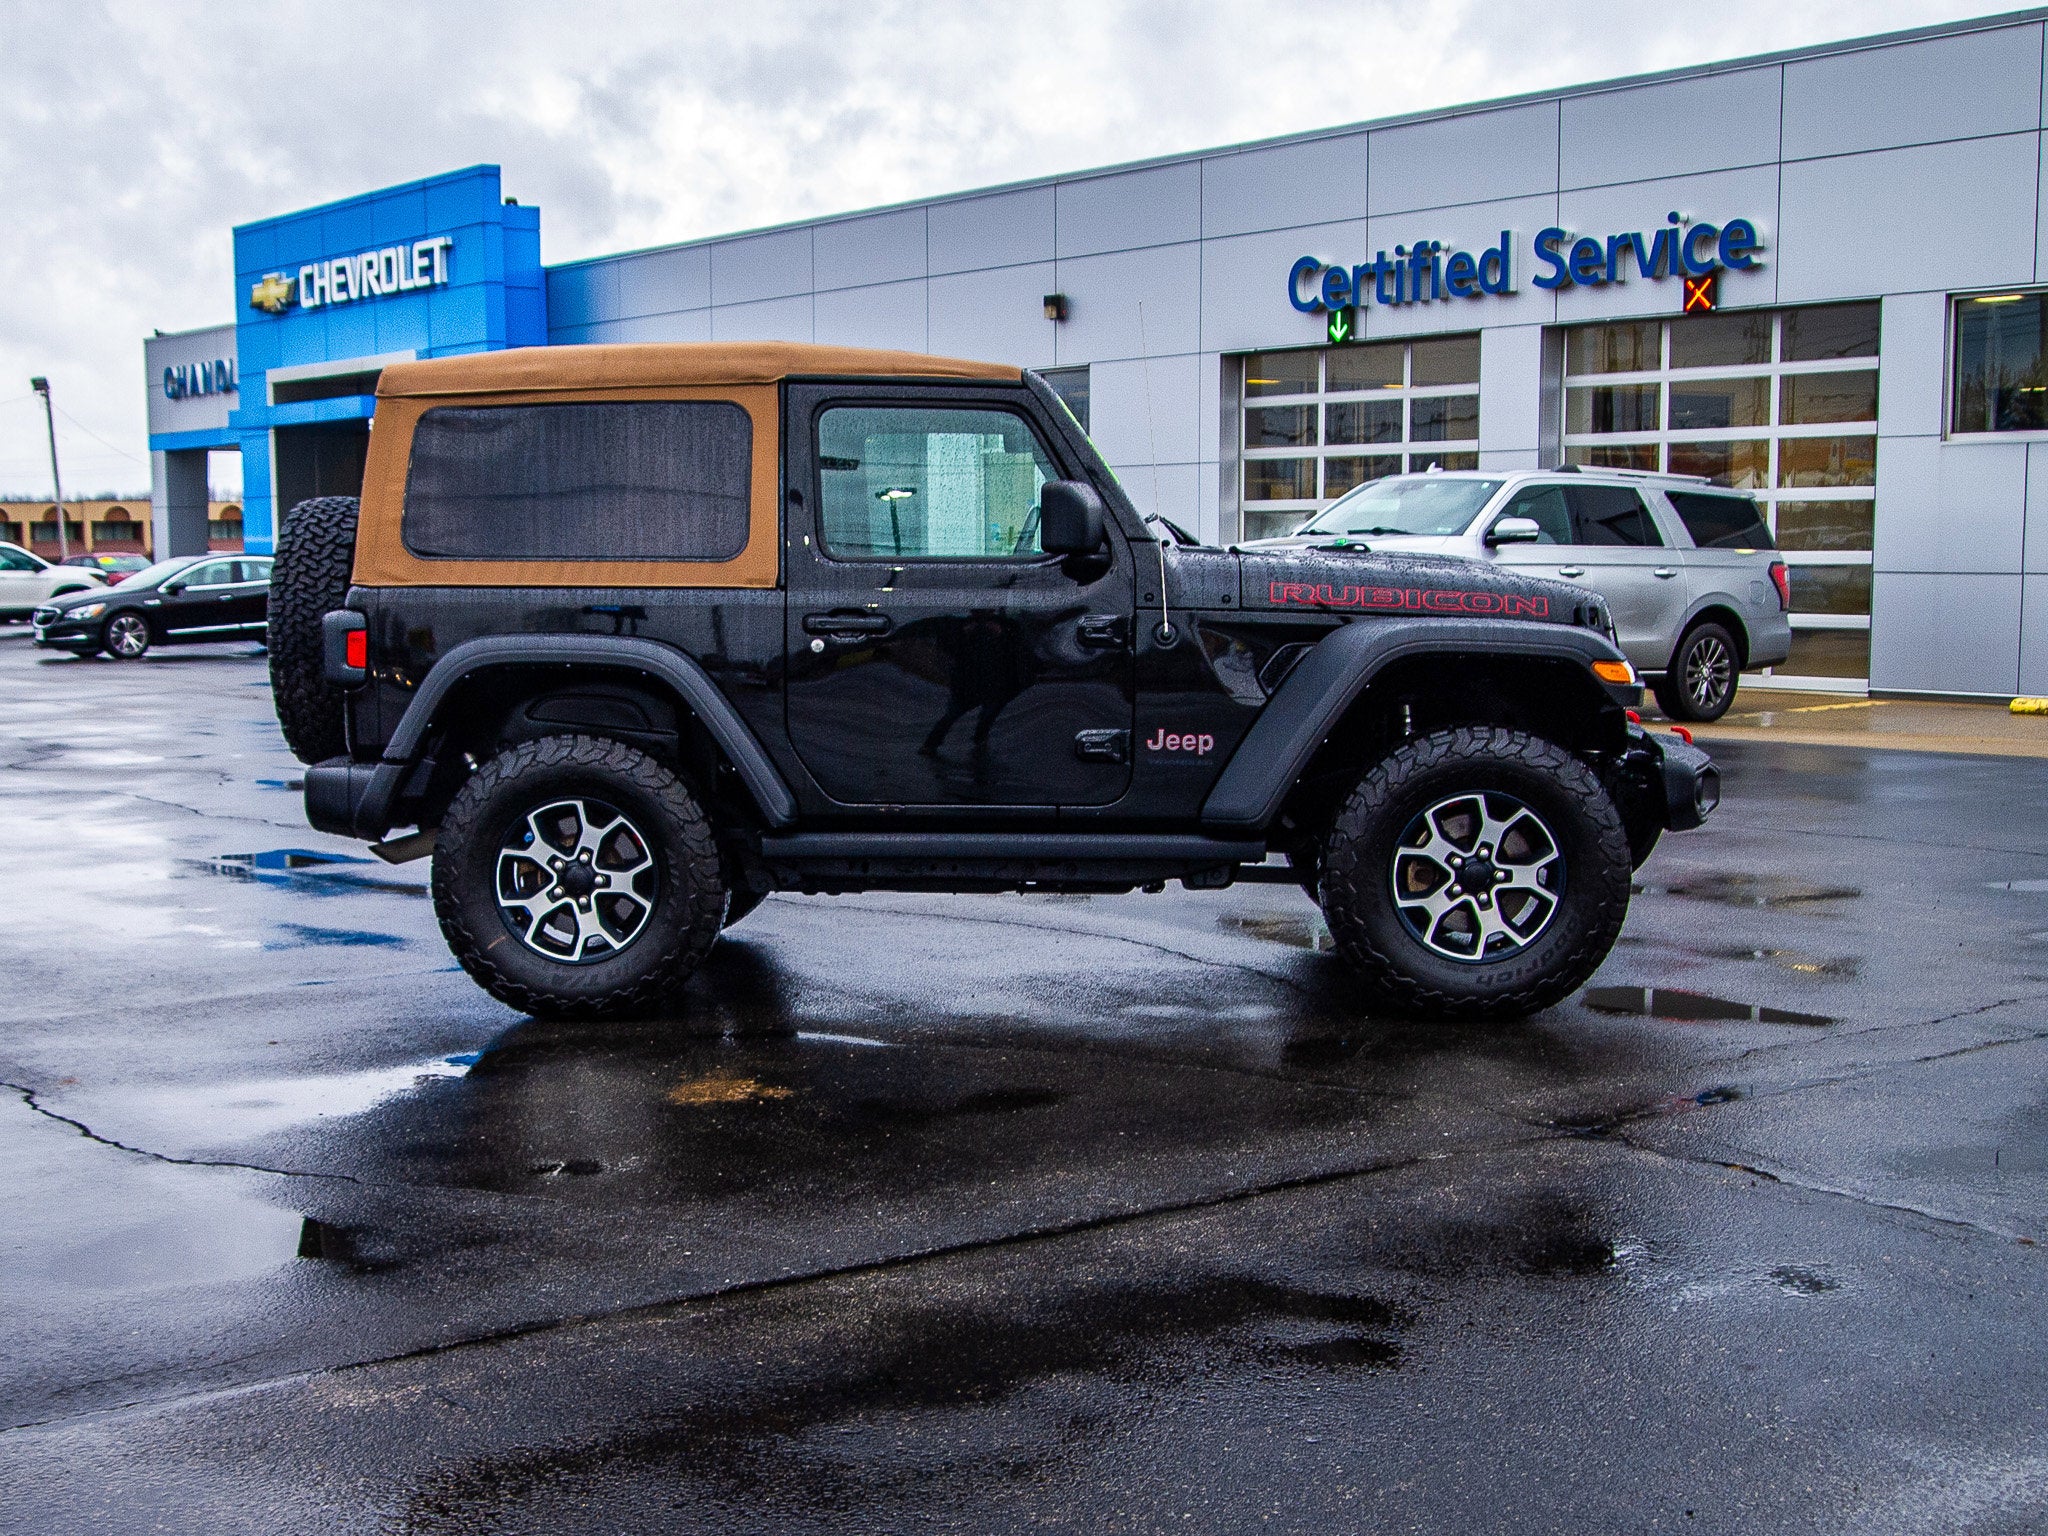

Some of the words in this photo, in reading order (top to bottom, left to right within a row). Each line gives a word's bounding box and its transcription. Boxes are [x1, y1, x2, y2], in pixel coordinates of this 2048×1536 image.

[299, 236, 449, 309] CHEVROLET
[1288, 229, 1511, 313] Certified
[1532, 211, 1757, 289] Service
[1270, 581, 1549, 617] RUBICON
[1147, 728, 1214, 756] Jeep
